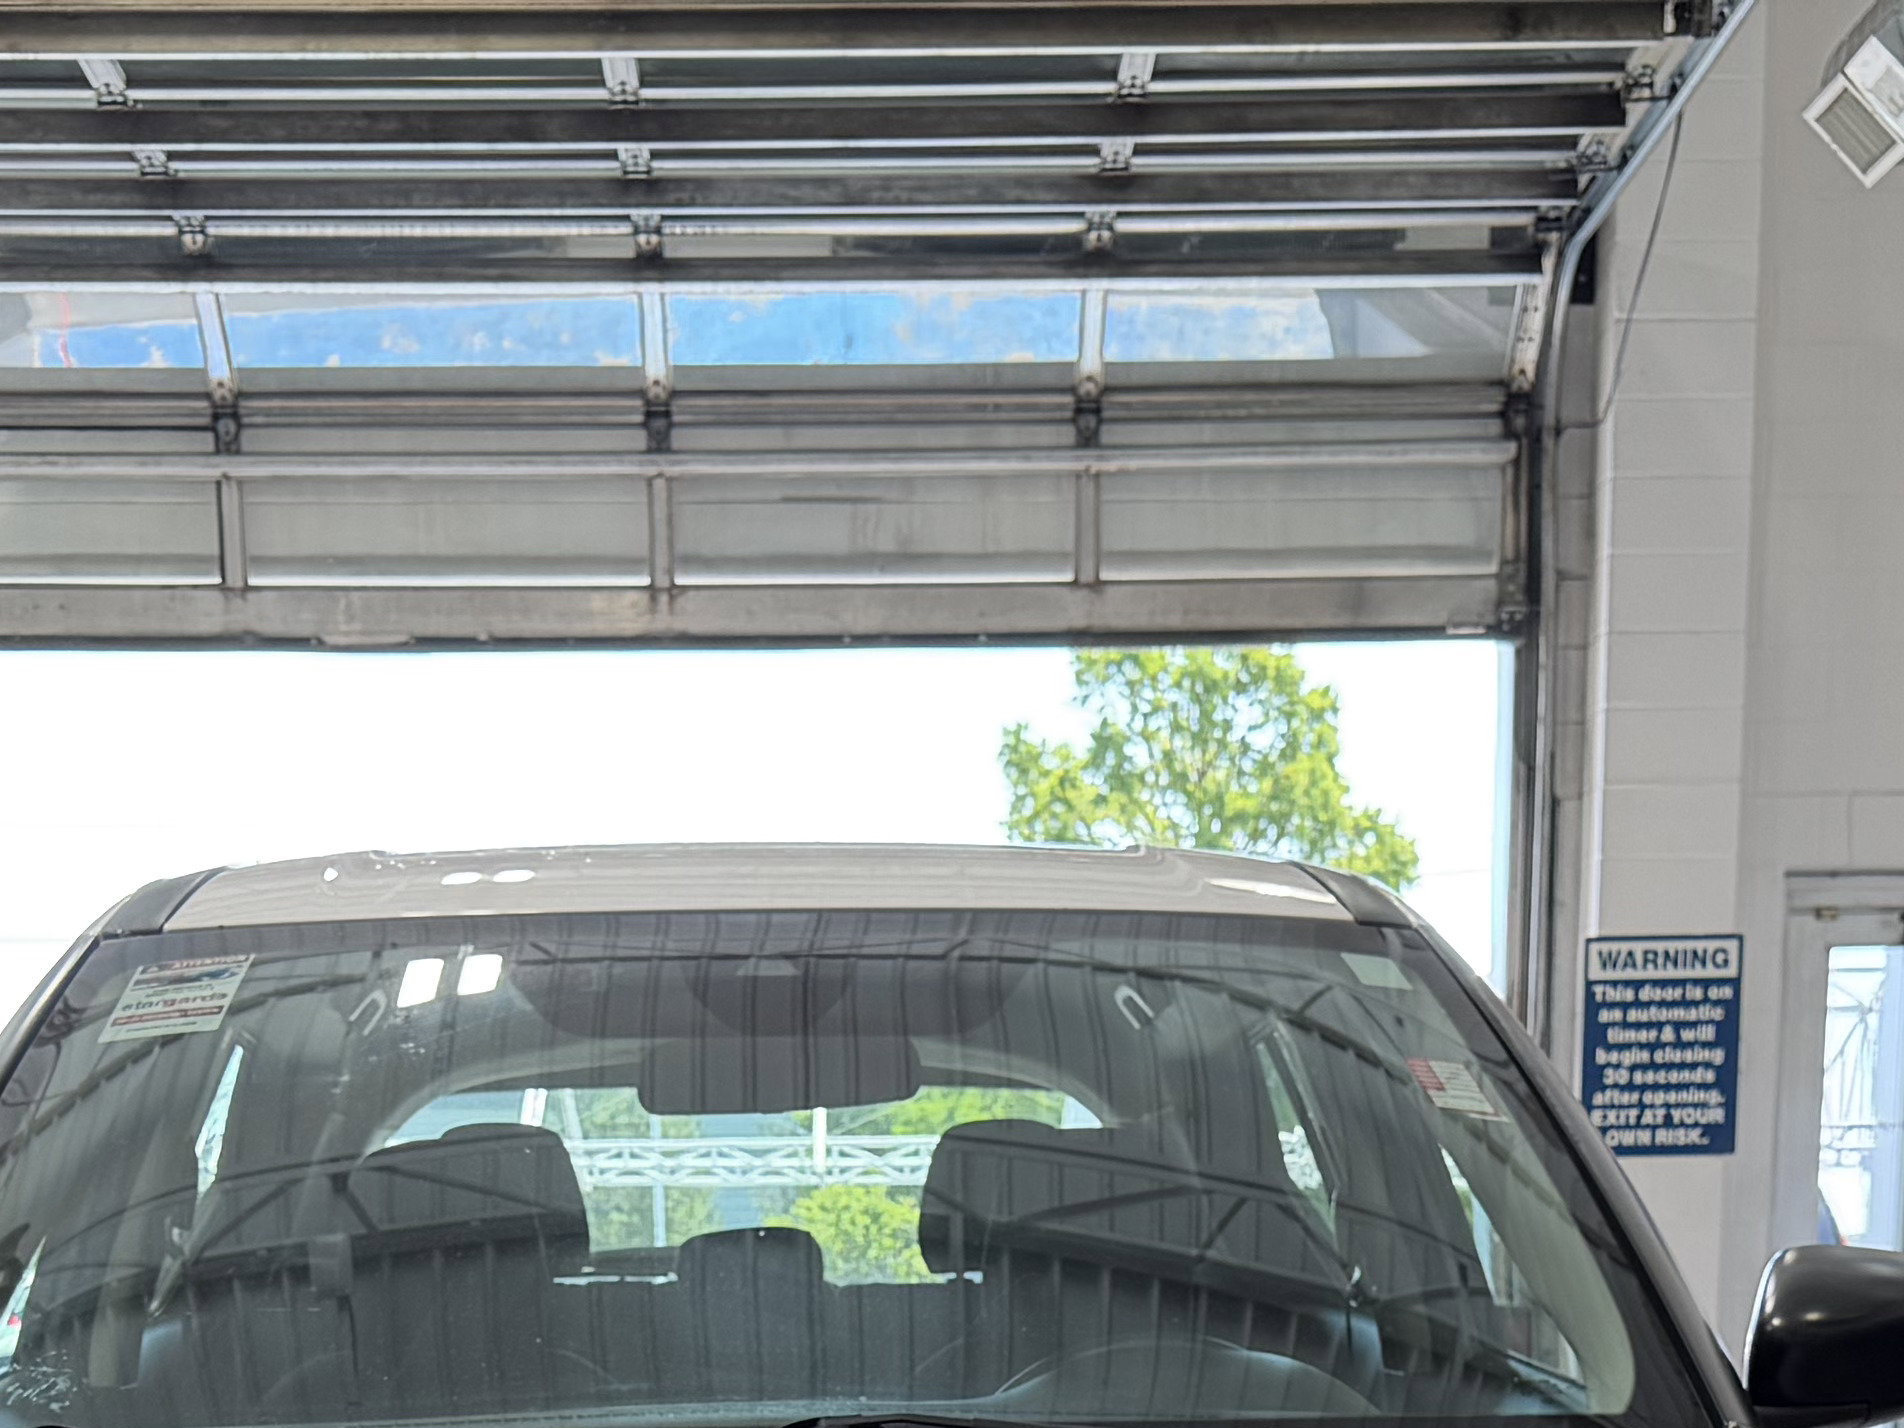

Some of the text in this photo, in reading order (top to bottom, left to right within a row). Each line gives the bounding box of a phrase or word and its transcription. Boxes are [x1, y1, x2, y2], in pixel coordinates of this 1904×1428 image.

[1598, 948, 1730, 971] WARNING
[1591, 982, 1734, 1002] This door is on
[1597, 1004, 1726, 1023] an automatic
[1606, 1023, 1716, 1044] timer & will
[1595, 1045, 1726, 1067] begin closing
[1602, 1066, 1717, 1086] 30 seconds
[1591, 1088, 1641, 1106] after
[1590, 1106, 1726, 1126] EXIT AT YOUR
[1604, 1127, 1711, 1147] OWN RISK.
